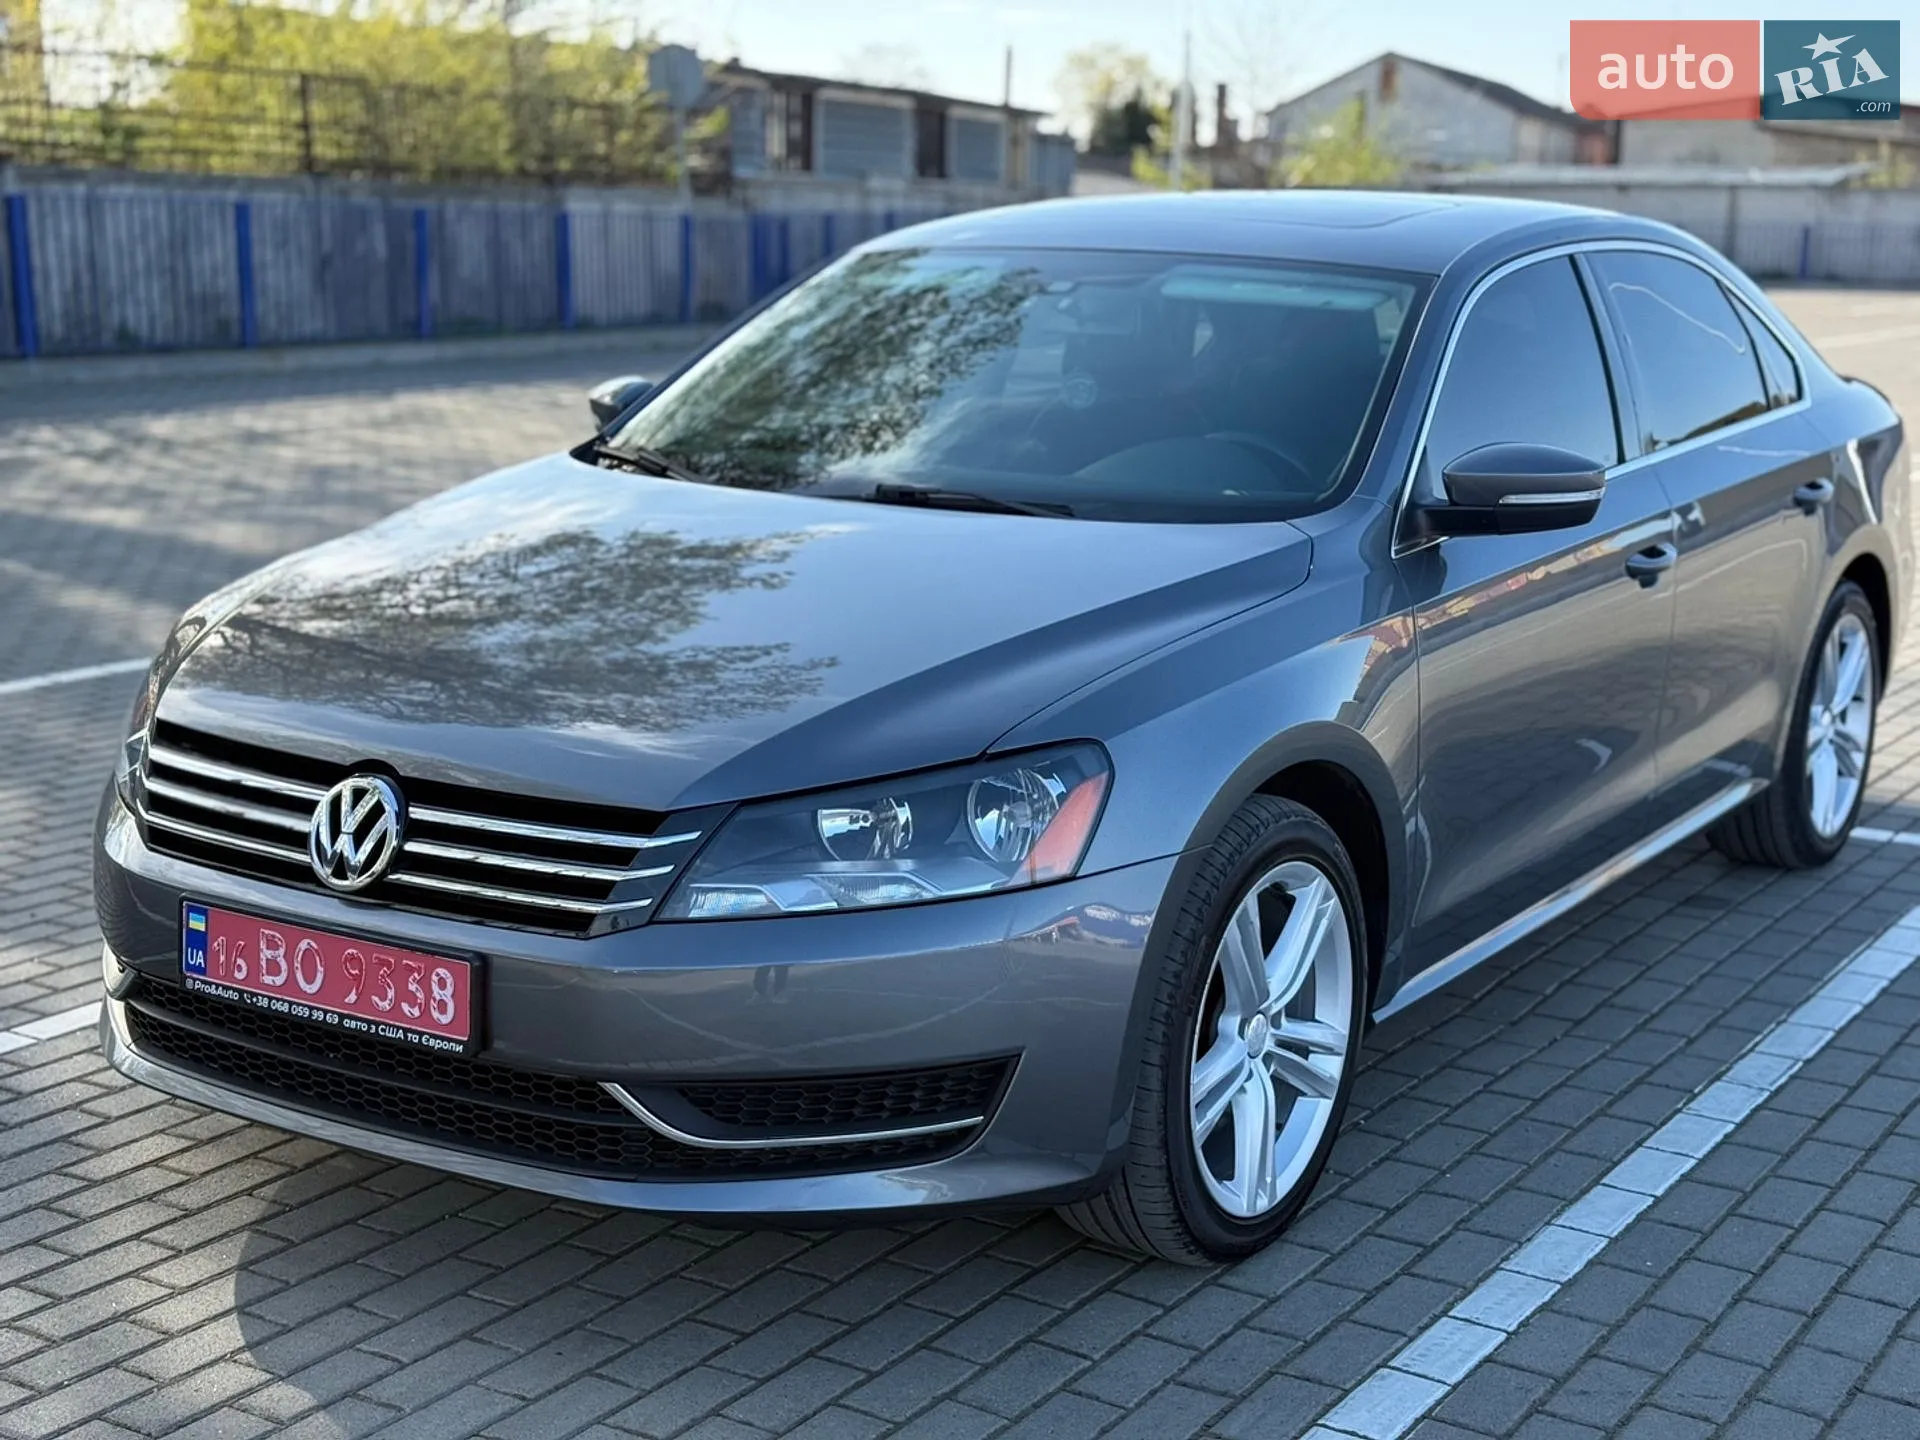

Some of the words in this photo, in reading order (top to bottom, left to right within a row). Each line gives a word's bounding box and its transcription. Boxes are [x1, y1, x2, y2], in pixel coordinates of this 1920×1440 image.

[187, 948, 205, 968] UA
[213, 935, 249, 981] 16
[341, 948, 456, 1025] 9338
[194, 980, 239, 1002] Pro&Auto
[252, 995, 270, 1009] +38
[270, 999, 289, 1013] 068
[291, 1004, 310, 1018] 059
[311, 1009, 324, 1022] 99
[326, 1013, 339, 1026] 69
[343, 1018, 368, 1033] авто
[378, 1024, 404, 1040] США
[406, 1033, 419, 1043] та
[421, 1034, 463, 1054] Європи
